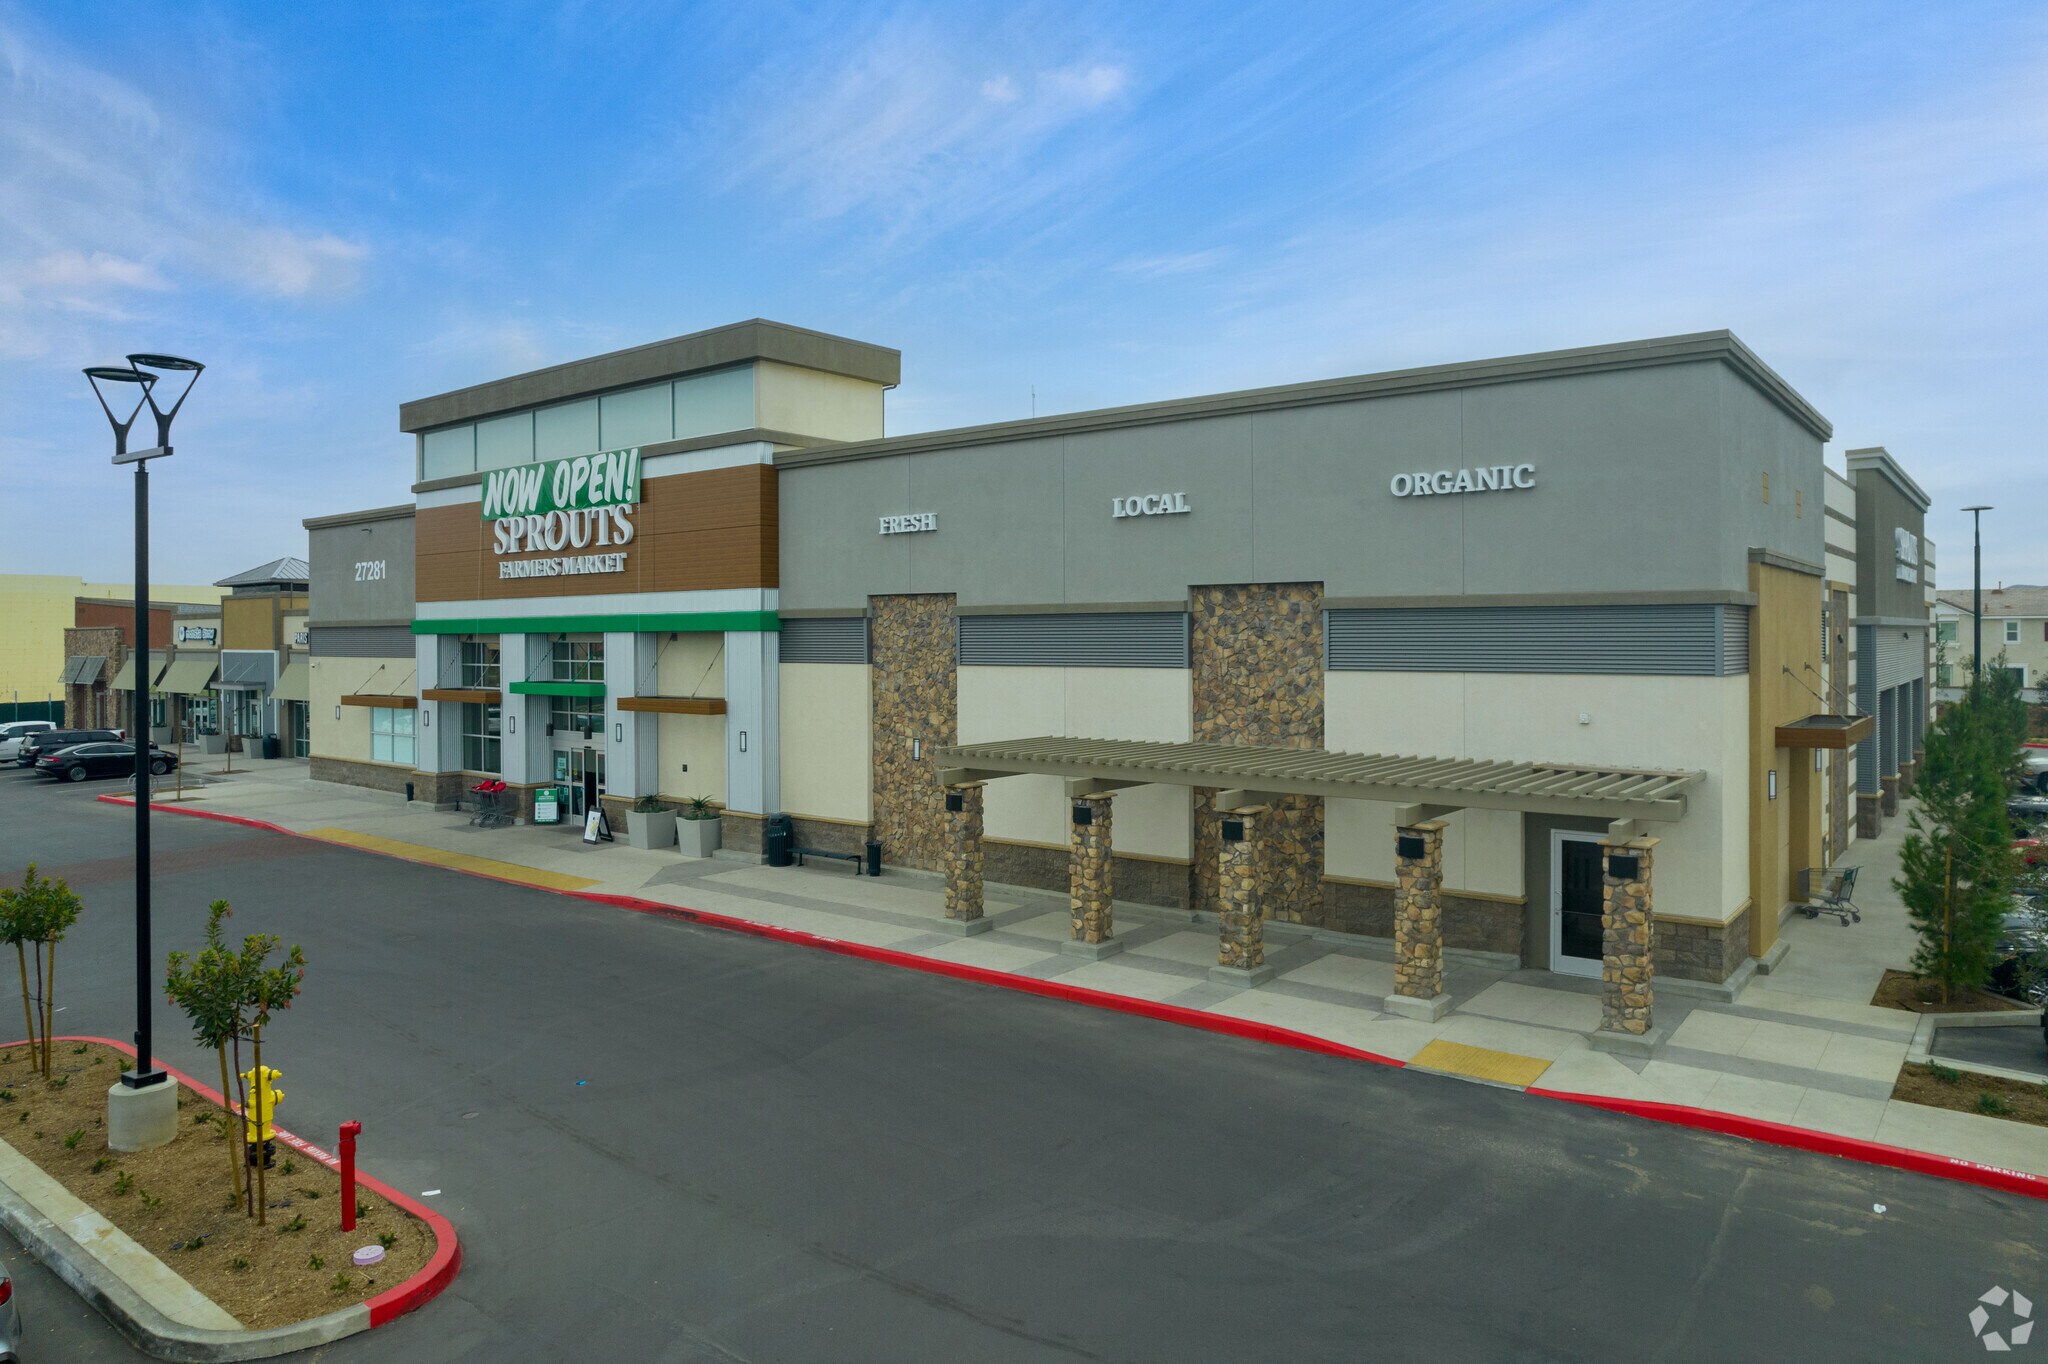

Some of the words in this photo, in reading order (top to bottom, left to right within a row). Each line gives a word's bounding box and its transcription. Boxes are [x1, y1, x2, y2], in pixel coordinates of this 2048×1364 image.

[483, 464, 545, 517] NOW
[553, 447, 638, 508] OPEN!
[1390, 463, 1535, 497] ORGANIC
[1112, 492, 1192, 518] LOCAL
[493, 504, 634, 555] SPROUTS
[879, 512, 938, 535] FRESH
[355, 560, 386, 581] 27281
[499, 557, 561, 579] FARMERS
[561, 552, 627, 576] MARKET
[1949, 1158, 1969, 1167] NO
[1976, 1163, 2036, 1180] PARKING
